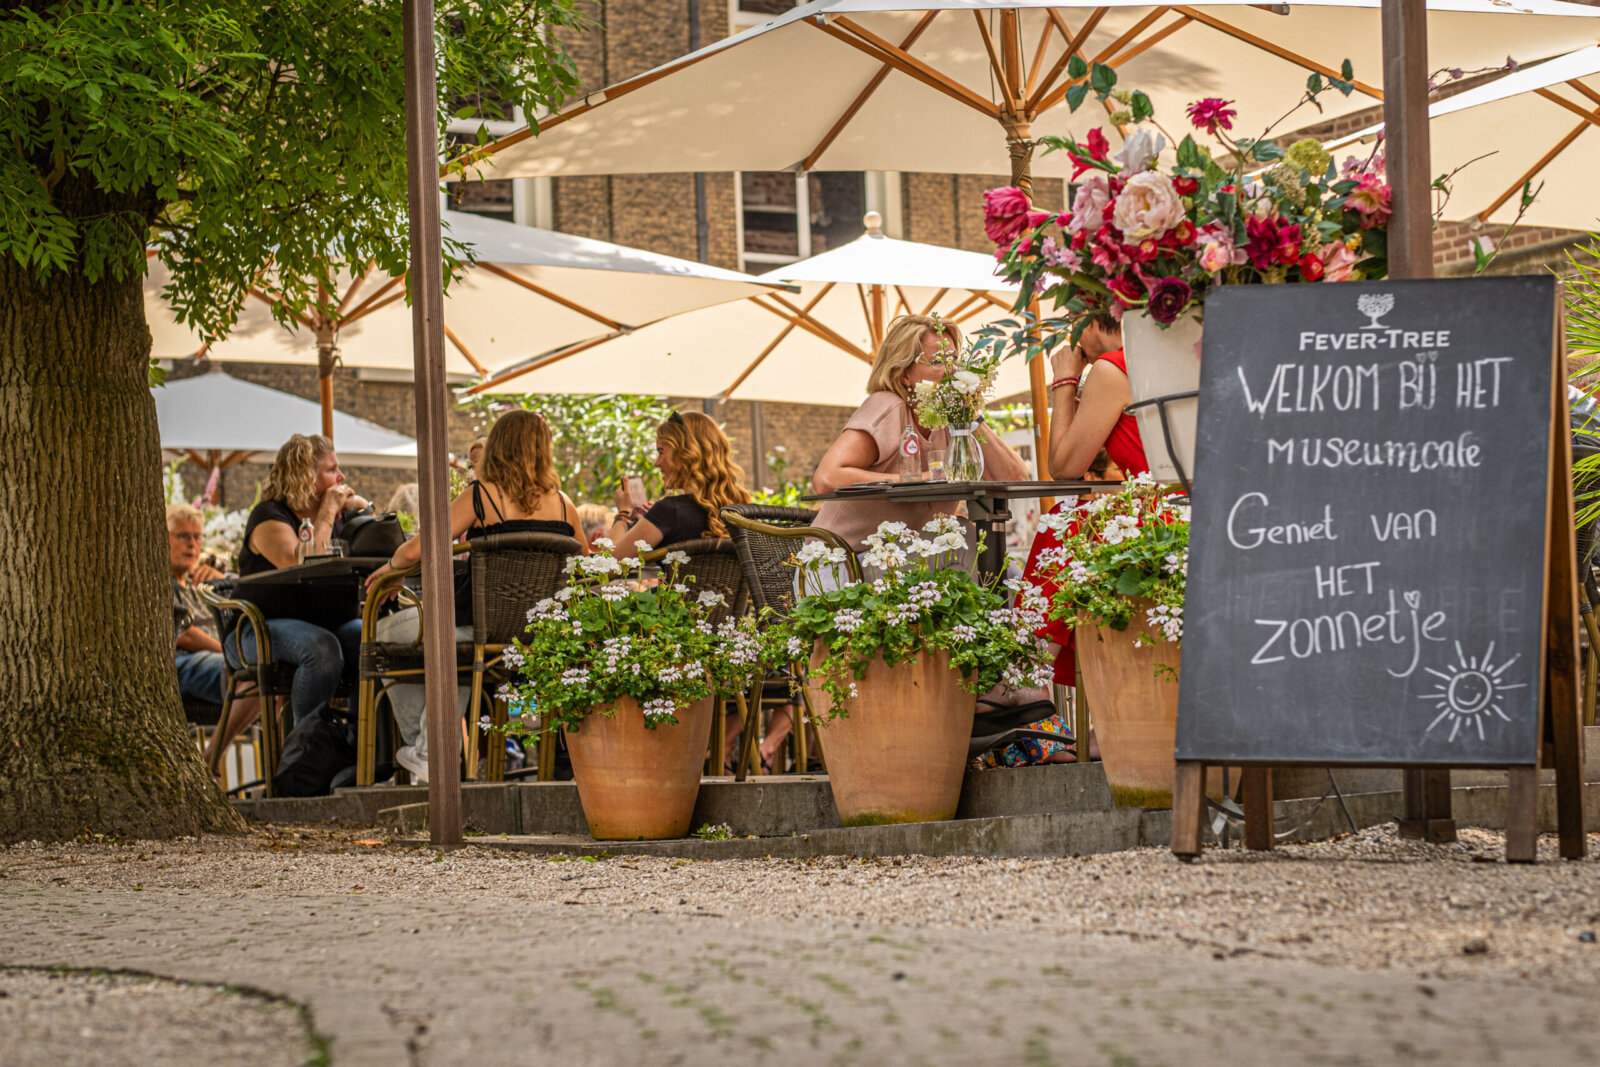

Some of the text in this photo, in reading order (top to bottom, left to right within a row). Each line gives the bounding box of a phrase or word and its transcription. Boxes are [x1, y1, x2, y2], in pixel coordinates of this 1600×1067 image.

[1299, 329, 1451, 351] FEVER-TREE
[1236, 362, 1380, 419] WELKOM
[1456, 356, 1514, 409] HET
[1227, 491, 1338, 550] Geniet
[1314, 560, 1381, 599] HET
